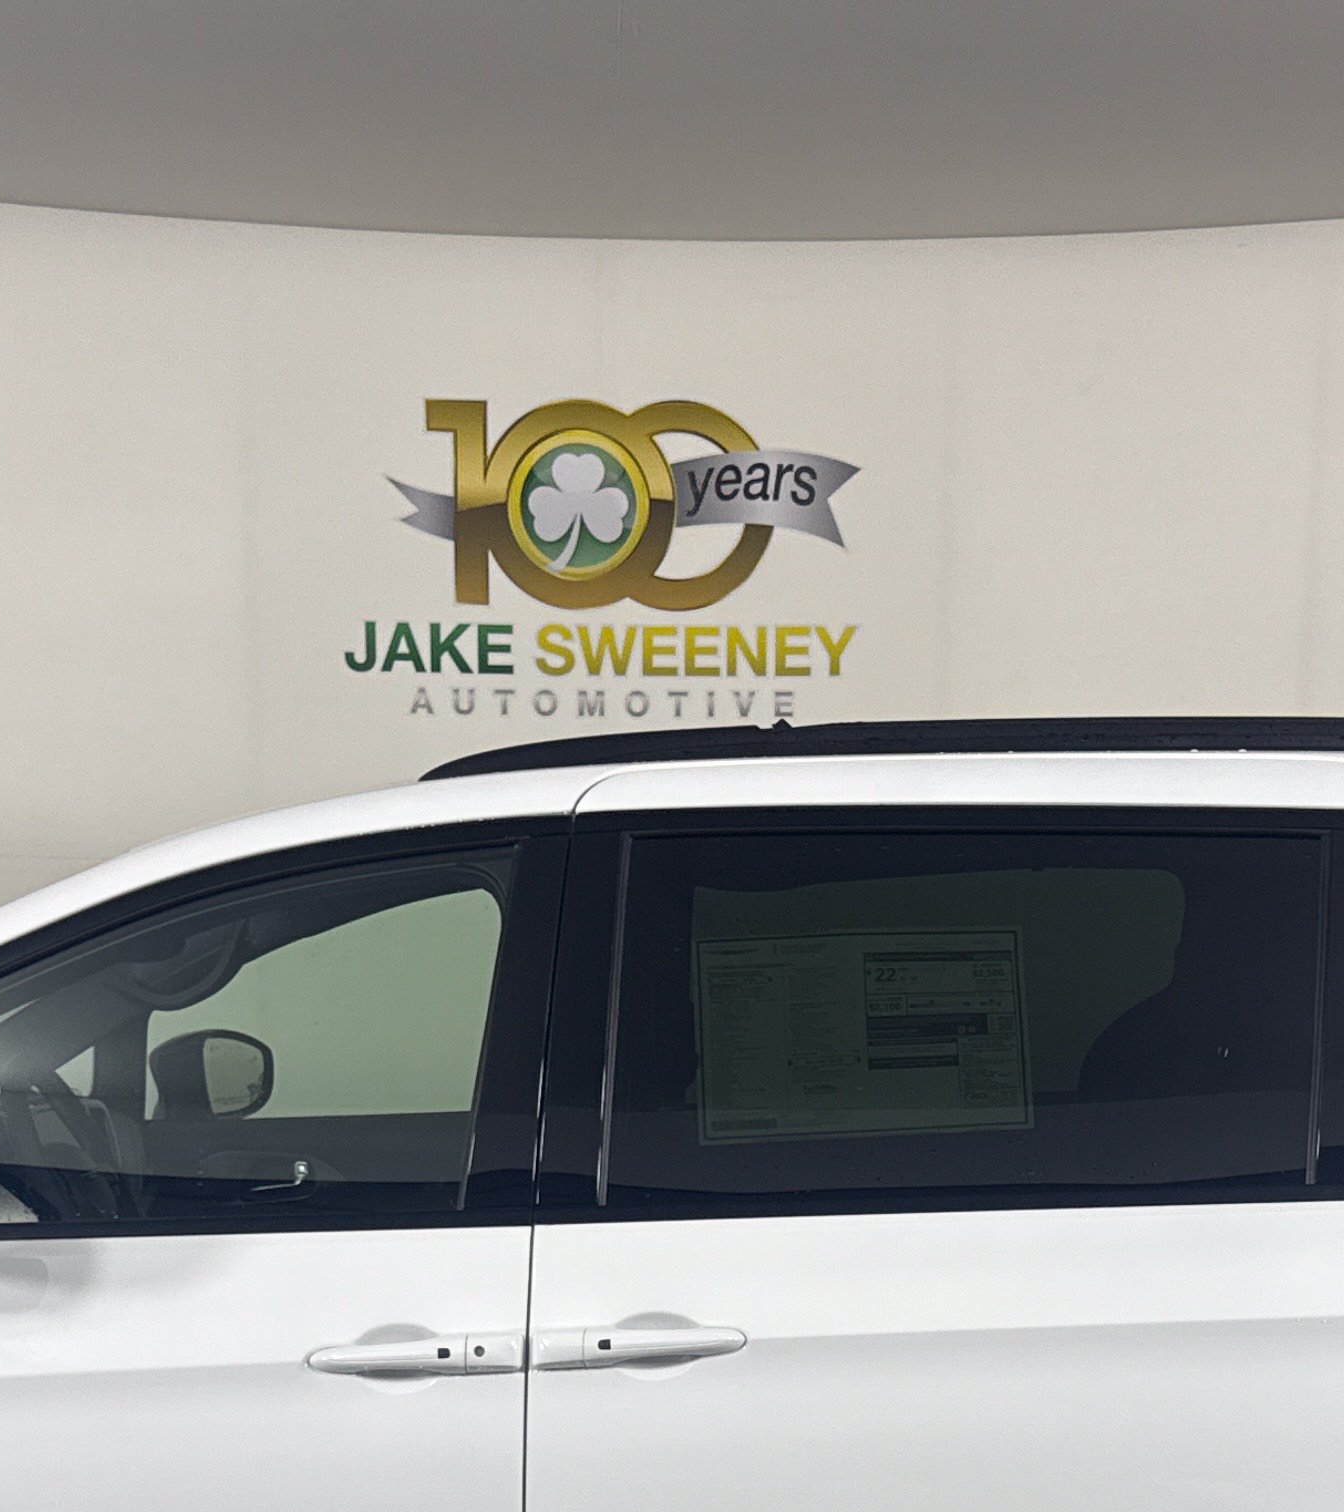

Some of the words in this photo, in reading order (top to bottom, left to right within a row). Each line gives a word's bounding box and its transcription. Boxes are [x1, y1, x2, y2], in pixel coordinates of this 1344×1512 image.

[423, 397, 775, 611] 100
[685, 462, 818, 517] years
[344, 620, 514, 675] JAKE
[535, 623, 858, 678] SWEENEY
[409, 687, 797, 719] AUTOMOTIVE
[874, 967, 897, 982] 22
